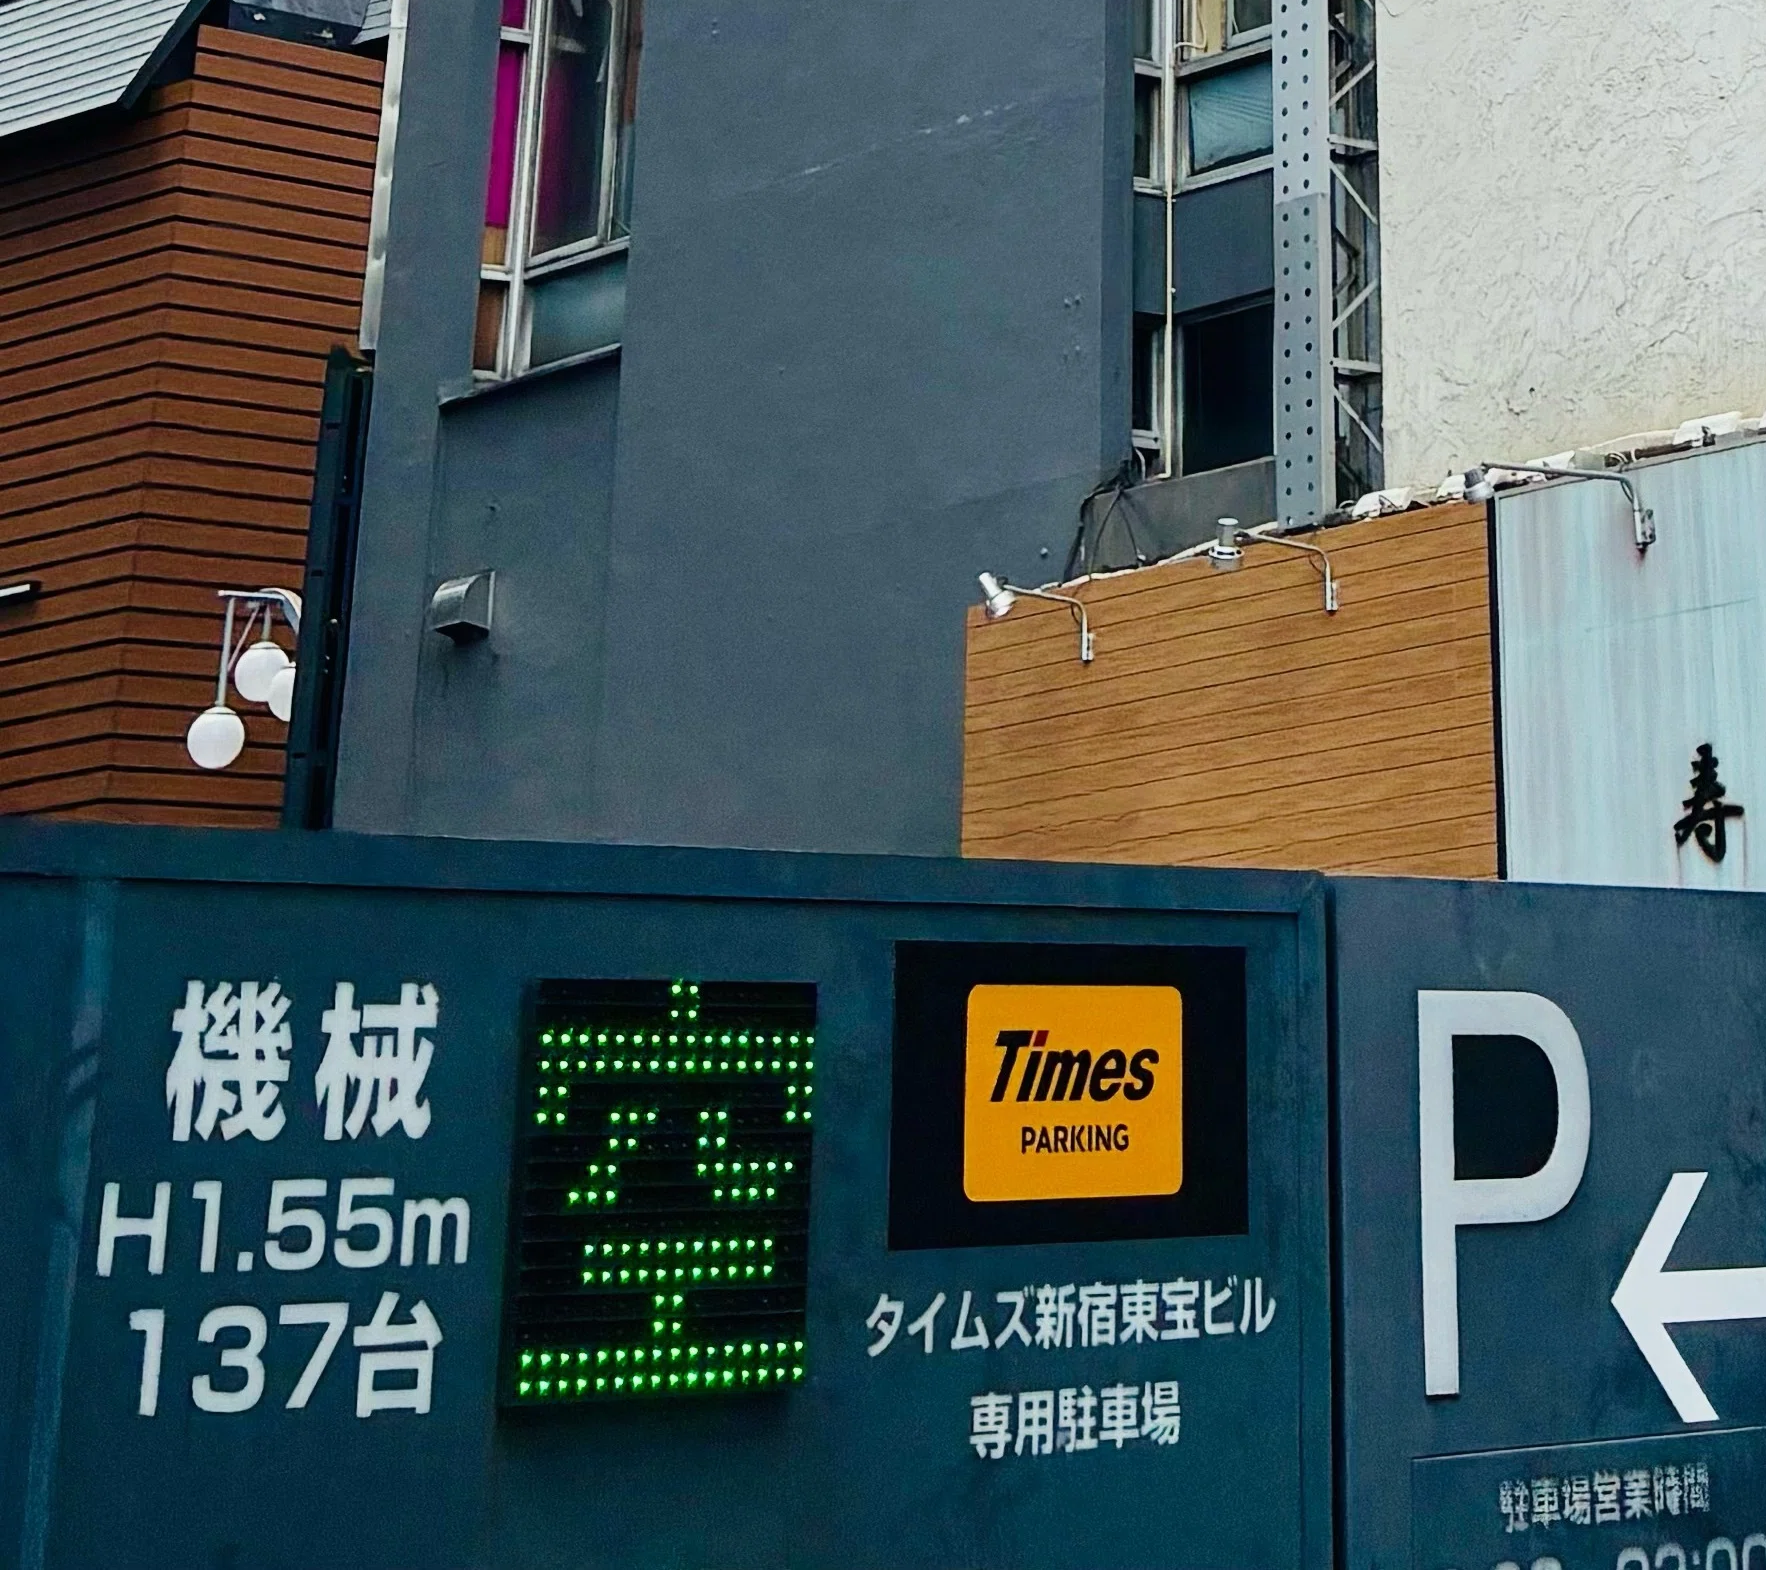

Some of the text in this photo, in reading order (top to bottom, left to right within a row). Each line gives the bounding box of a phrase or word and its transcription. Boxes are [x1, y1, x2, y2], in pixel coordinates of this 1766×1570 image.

[166, 978, 440, 1142] 機械
[989, 1029, 1160, 1104] Times
[1020, 1123, 1130, 1155] PARKING
[517, 976, 816, 1398] 空
[1418, 989, 1592, 1397] P
[128, 1291, 444, 1419] 137台
[865, 1274, 1276, 1359] タイムズ新宿東宝ビル
[968, 1379, 1183, 1460] 専用駐車場
[1499, 1462, 1711, 1534] 駐車場営業時間
